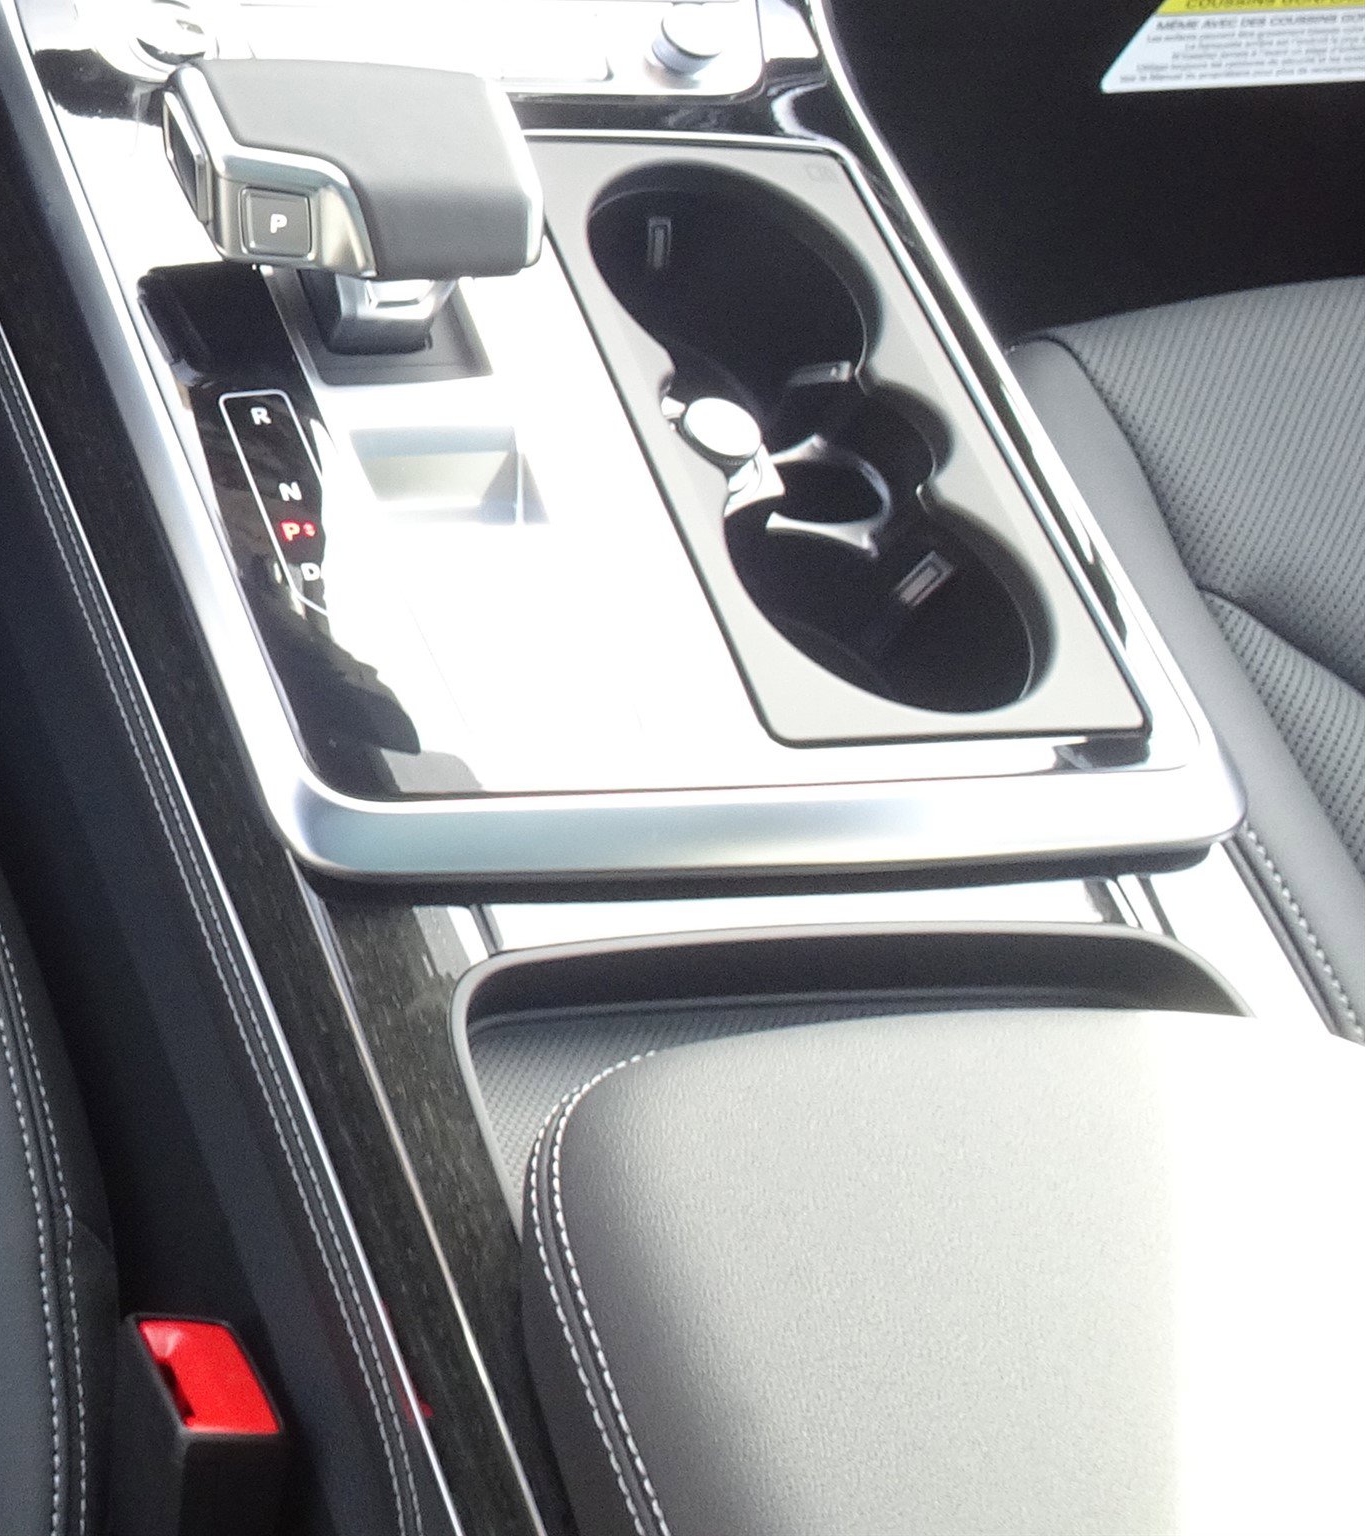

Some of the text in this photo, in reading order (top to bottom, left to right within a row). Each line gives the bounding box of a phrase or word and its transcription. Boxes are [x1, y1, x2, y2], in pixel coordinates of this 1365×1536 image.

[269, 214, 288, 234] P
[250, 406, 272, 425] R
[278, 481, 302, 502] N
[280, 521, 301, 542] P
[300, 562, 320, 582] D
